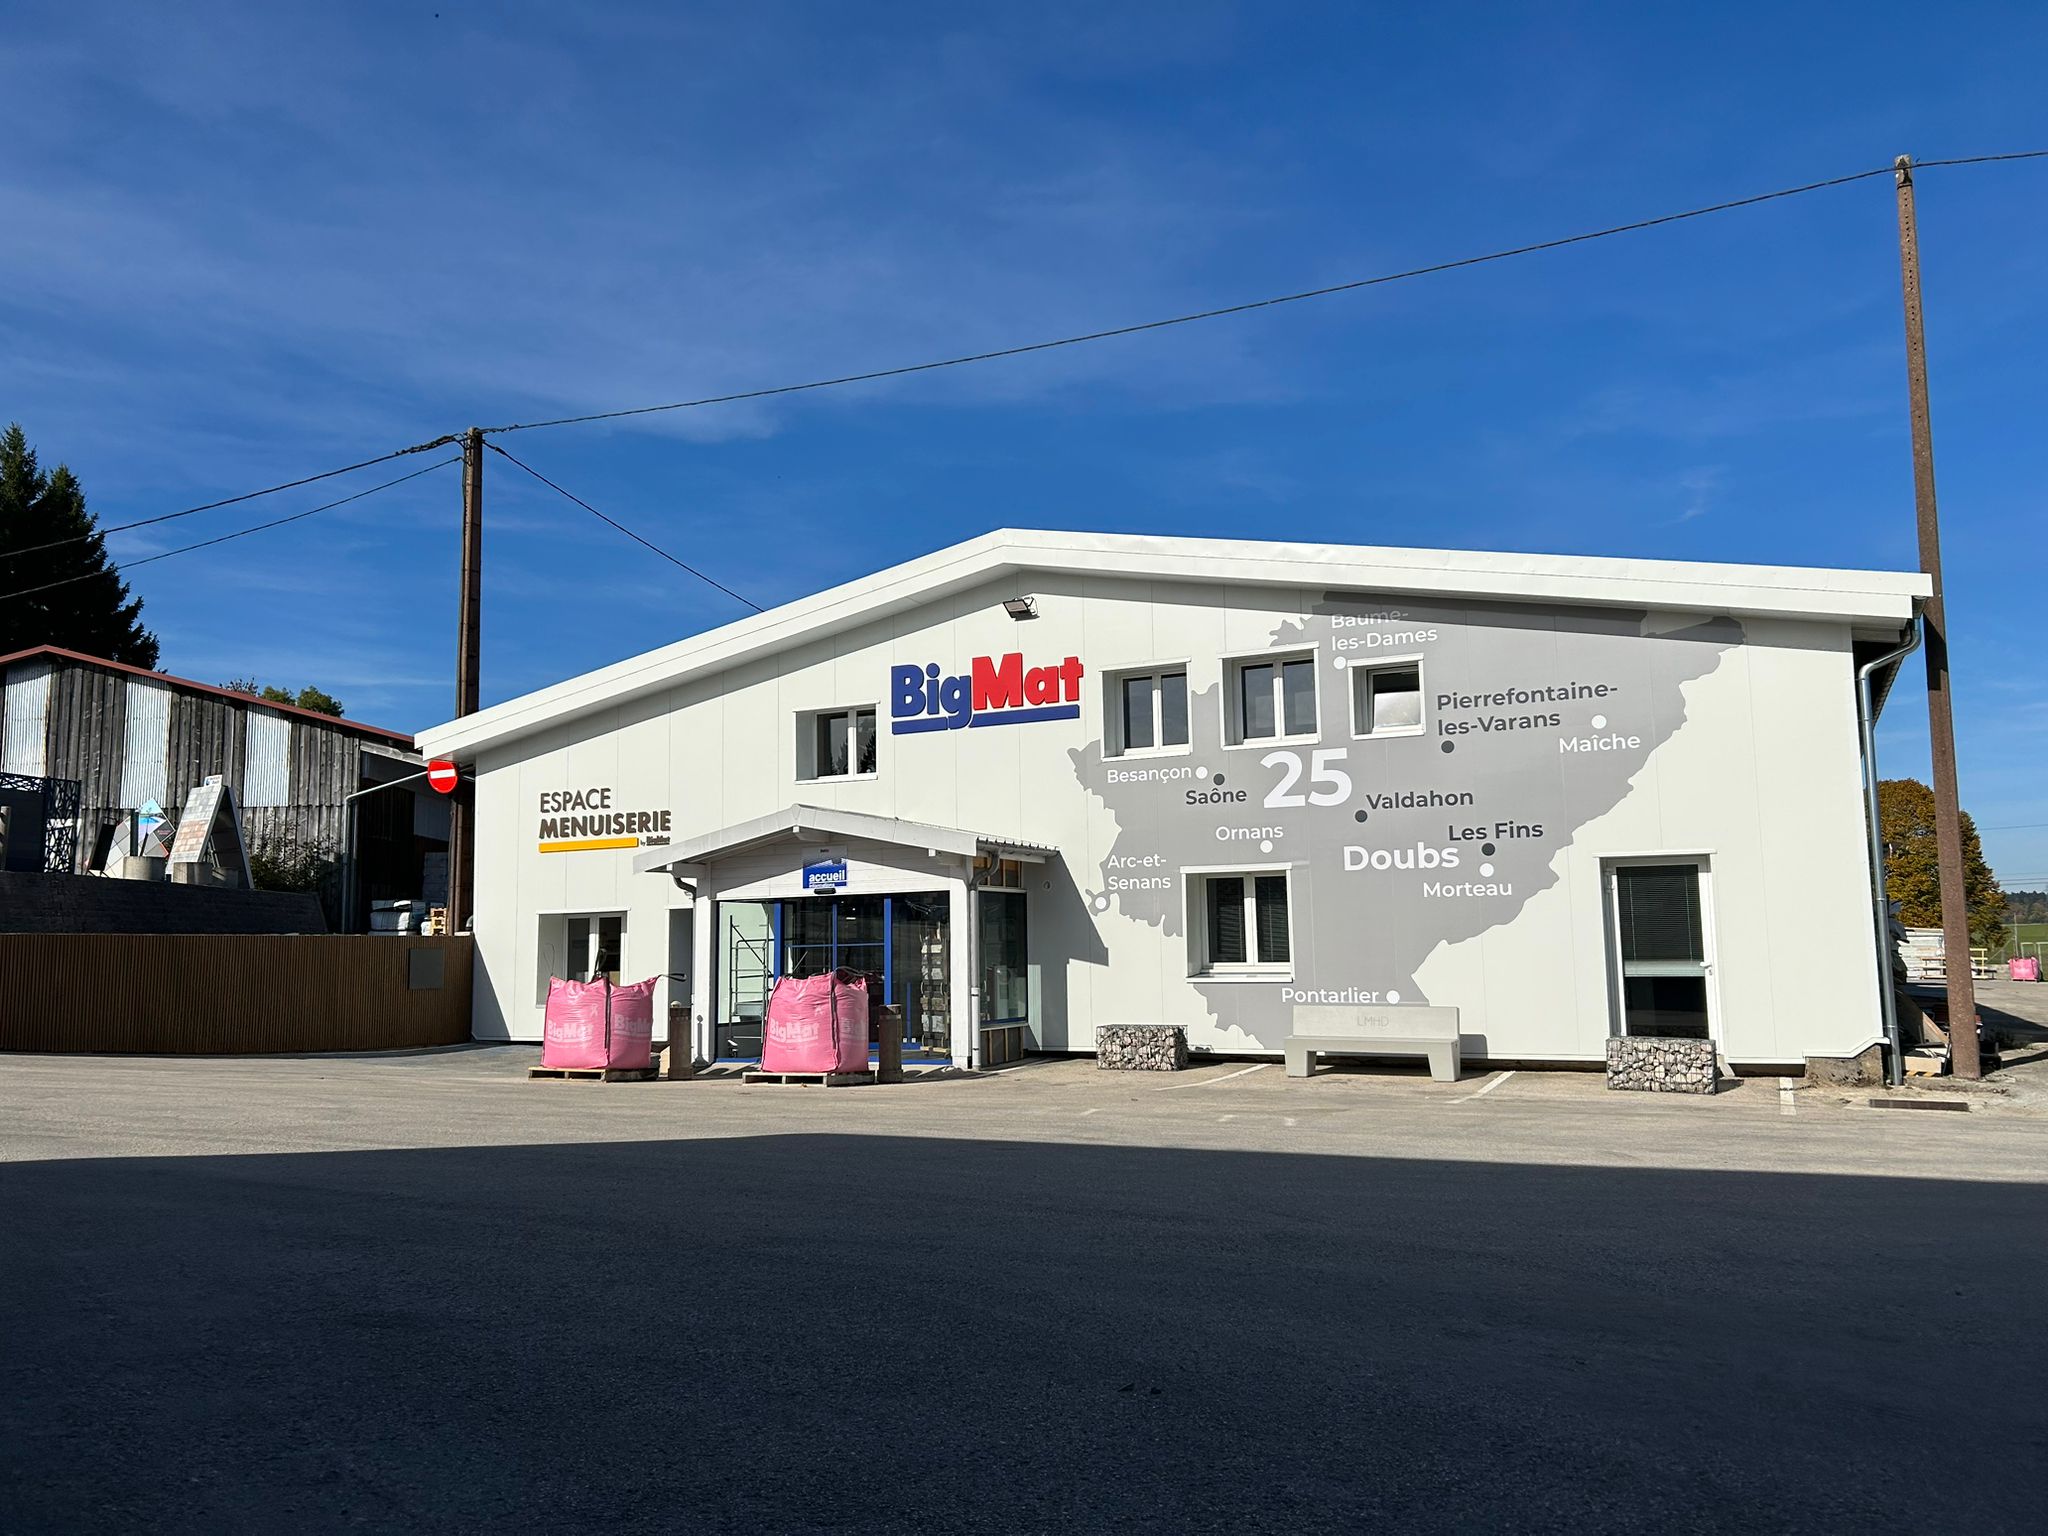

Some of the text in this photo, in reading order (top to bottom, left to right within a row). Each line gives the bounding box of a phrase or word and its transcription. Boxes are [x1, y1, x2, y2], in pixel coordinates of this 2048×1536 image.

[1331, 610, 1408, 629] Baume-
[1331, 629, 1438, 651] les-Dames
[891, 652, 1084, 731] BigMat
[1437, 681, 1618, 710] Pierrefontaine-
[1438, 712, 1561, 736] les-Varans
[1559, 733, 1641, 753] Maîche
[1107, 766, 1192, 784] Besançon
[1260, 747, 1352, 808] 25
[540, 788, 611, 813] ESPACE
[1186, 787, 1247, 805] Saône
[1366, 790, 1474, 809] Valdahon
[539, 810, 672, 839] MENUISERIE
[1215, 825, 1284, 841] Ornans
[1448, 820, 1544, 841] Les Fins
[1107, 854, 1167, 869] Arc-et-
[1343, 842, 1460, 871] Doubs
[809, 870, 845, 882] accueil
[1108, 876, 1172, 891] Senans
[1423, 882, 1512, 898] Morteau
[1281, 987, 1379, 1003] Pontarlier
